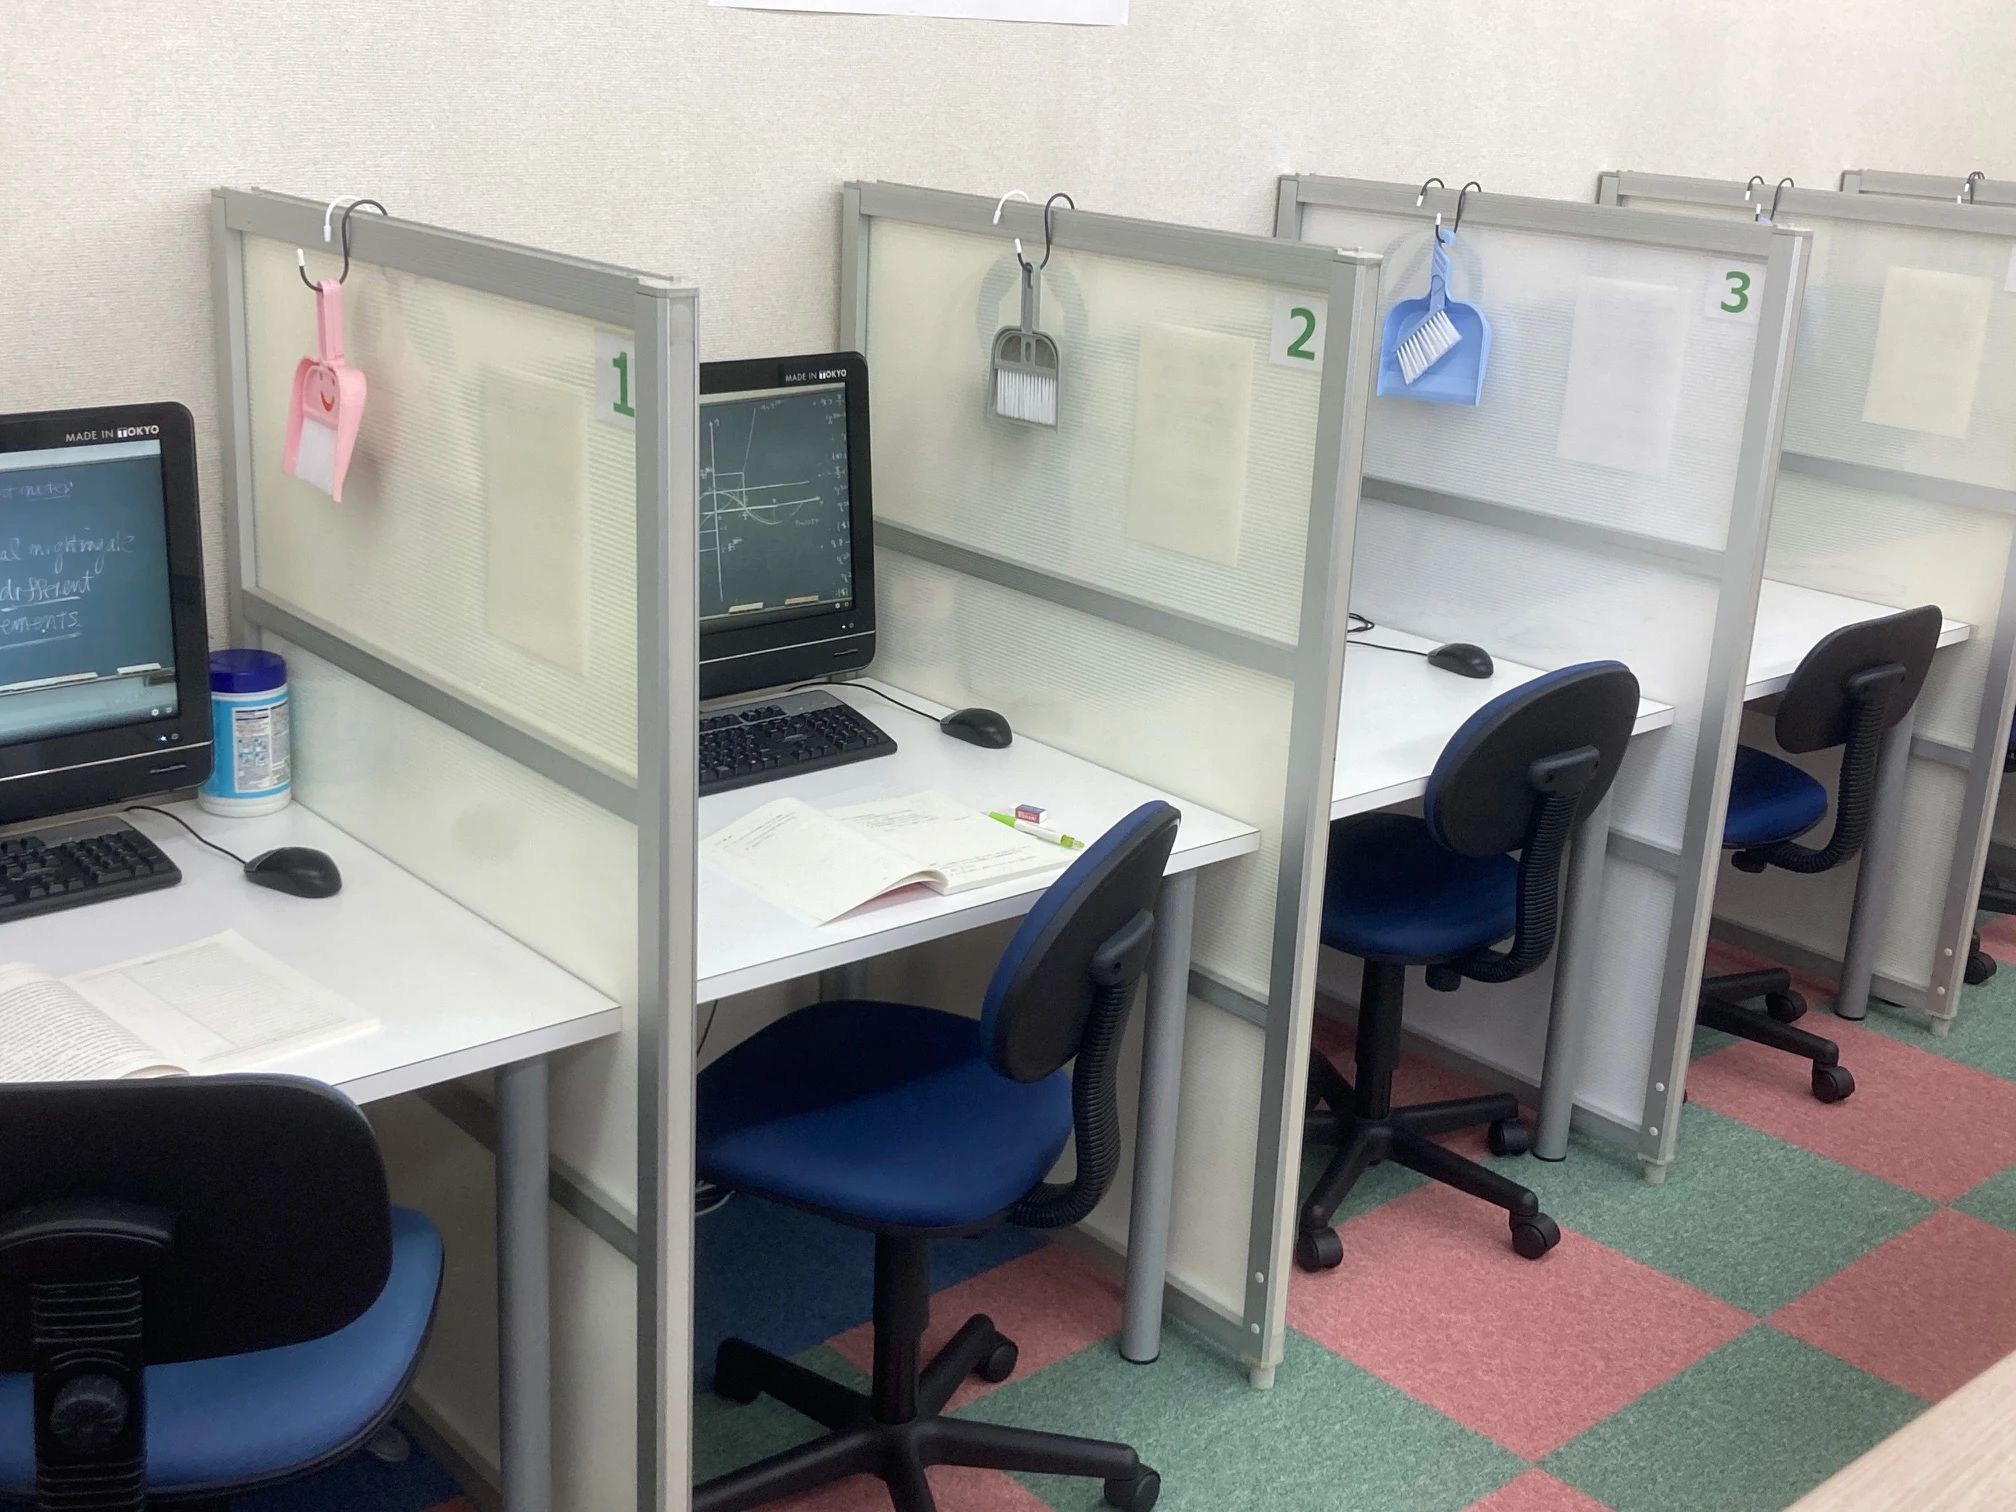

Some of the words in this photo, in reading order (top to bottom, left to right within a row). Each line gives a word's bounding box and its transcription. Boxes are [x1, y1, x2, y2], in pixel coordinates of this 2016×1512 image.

[1720, 271, 1750, 313] 3
[1286, 307, 1315, 361] 2
[612, 351, 635, 418] 1
[785, 372, 807, 382] MADE
[808, 371, 818, 380] IN
[818, 368, 847, 380] TOKYO
[65, 430, 97, 442] MADE
[101, 429, 114, 439] IN
[117, 424, 160, 438] TOKYO
